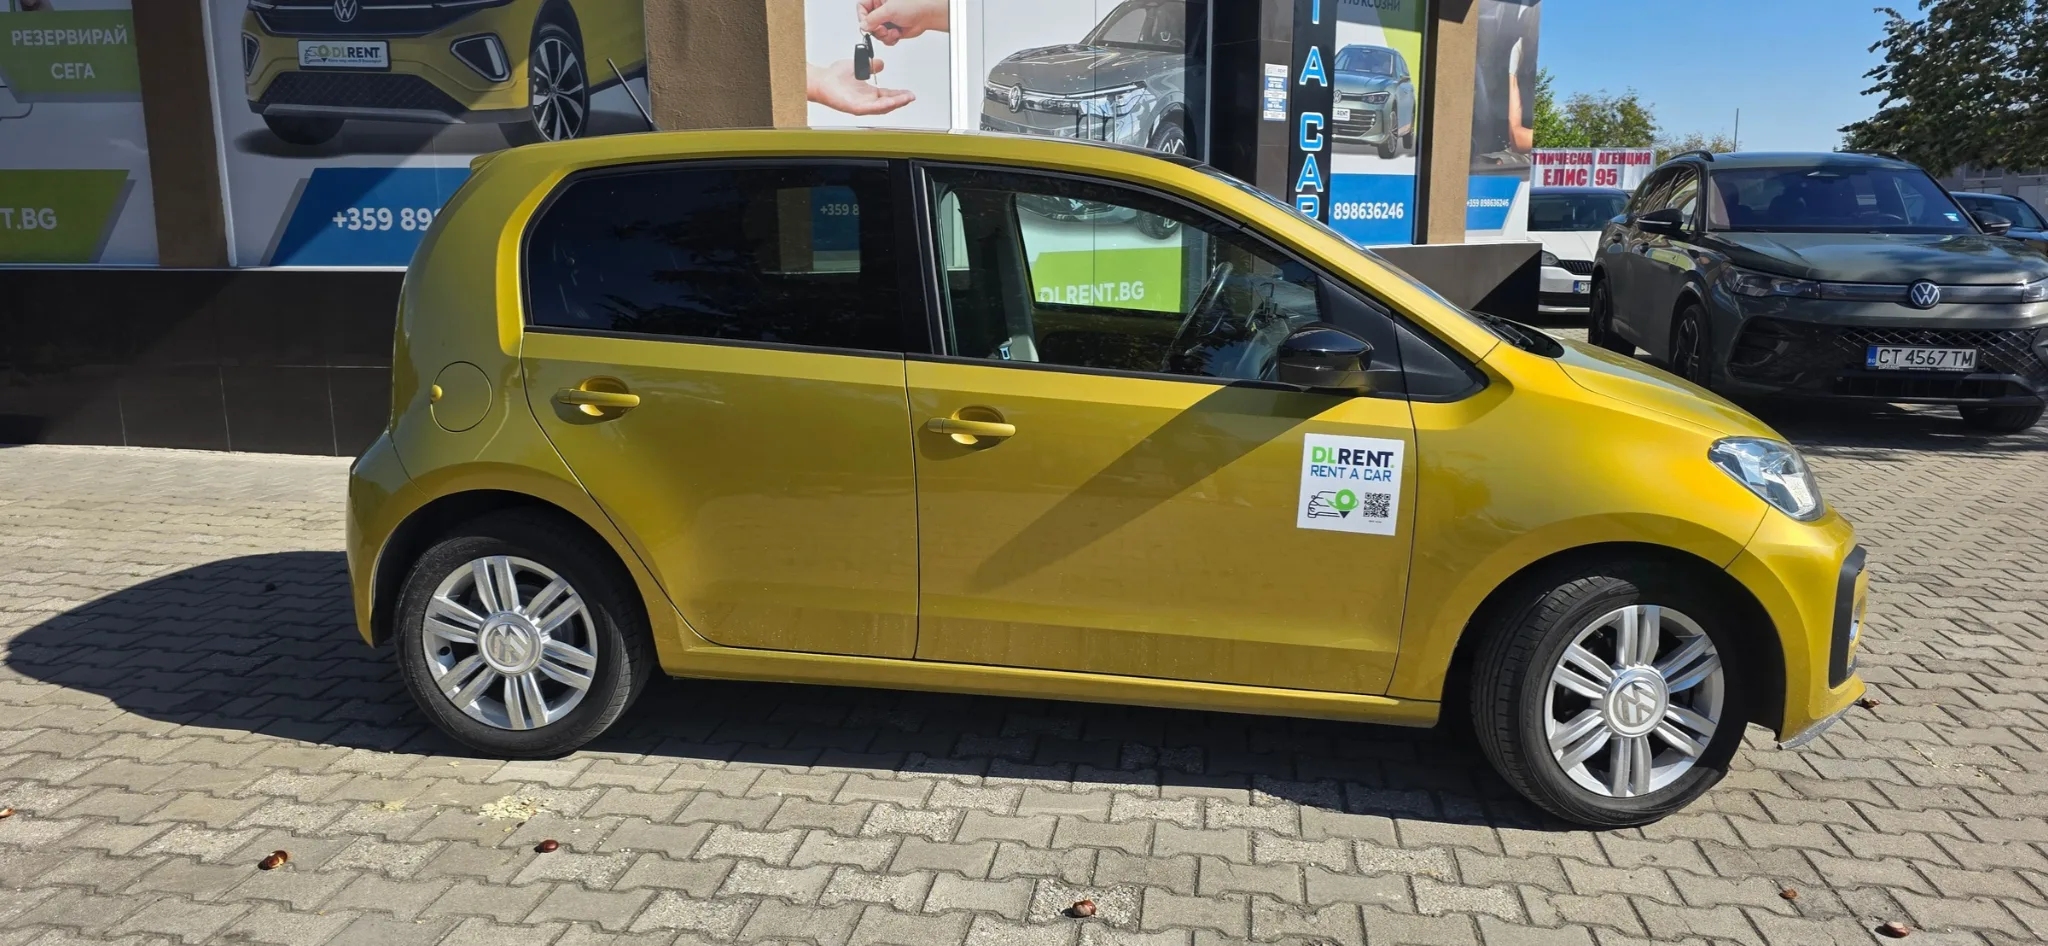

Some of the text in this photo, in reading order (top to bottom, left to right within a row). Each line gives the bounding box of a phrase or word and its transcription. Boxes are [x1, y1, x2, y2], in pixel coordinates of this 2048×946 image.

[11, 24, 128, 46] РЕЗЕРВИРАЙ
[332, 46, 380, 58] DLRENT
[51, 62, 96, 80] СЕГА
[1299, 46, 1328, 87] A
[1597, 152, 1651, 166] АГЕНЦИЯ
[1543, 168, 1618, 187] ЕЛИС 95
[820, 203, 850, 216] +359
[1333, 202, 1404, 220] 898636246
[332, 207, 441, 231] +359 89
[1038, 281, 1145, 304] DLRENT.BG
[1905, 350, 1948, 366] 4567
[1952, 351, 1974, 367] TM
[1311, 446, 1395, 468] DLRENT
[1311, 464, 1392, 482] RENT A CAR
